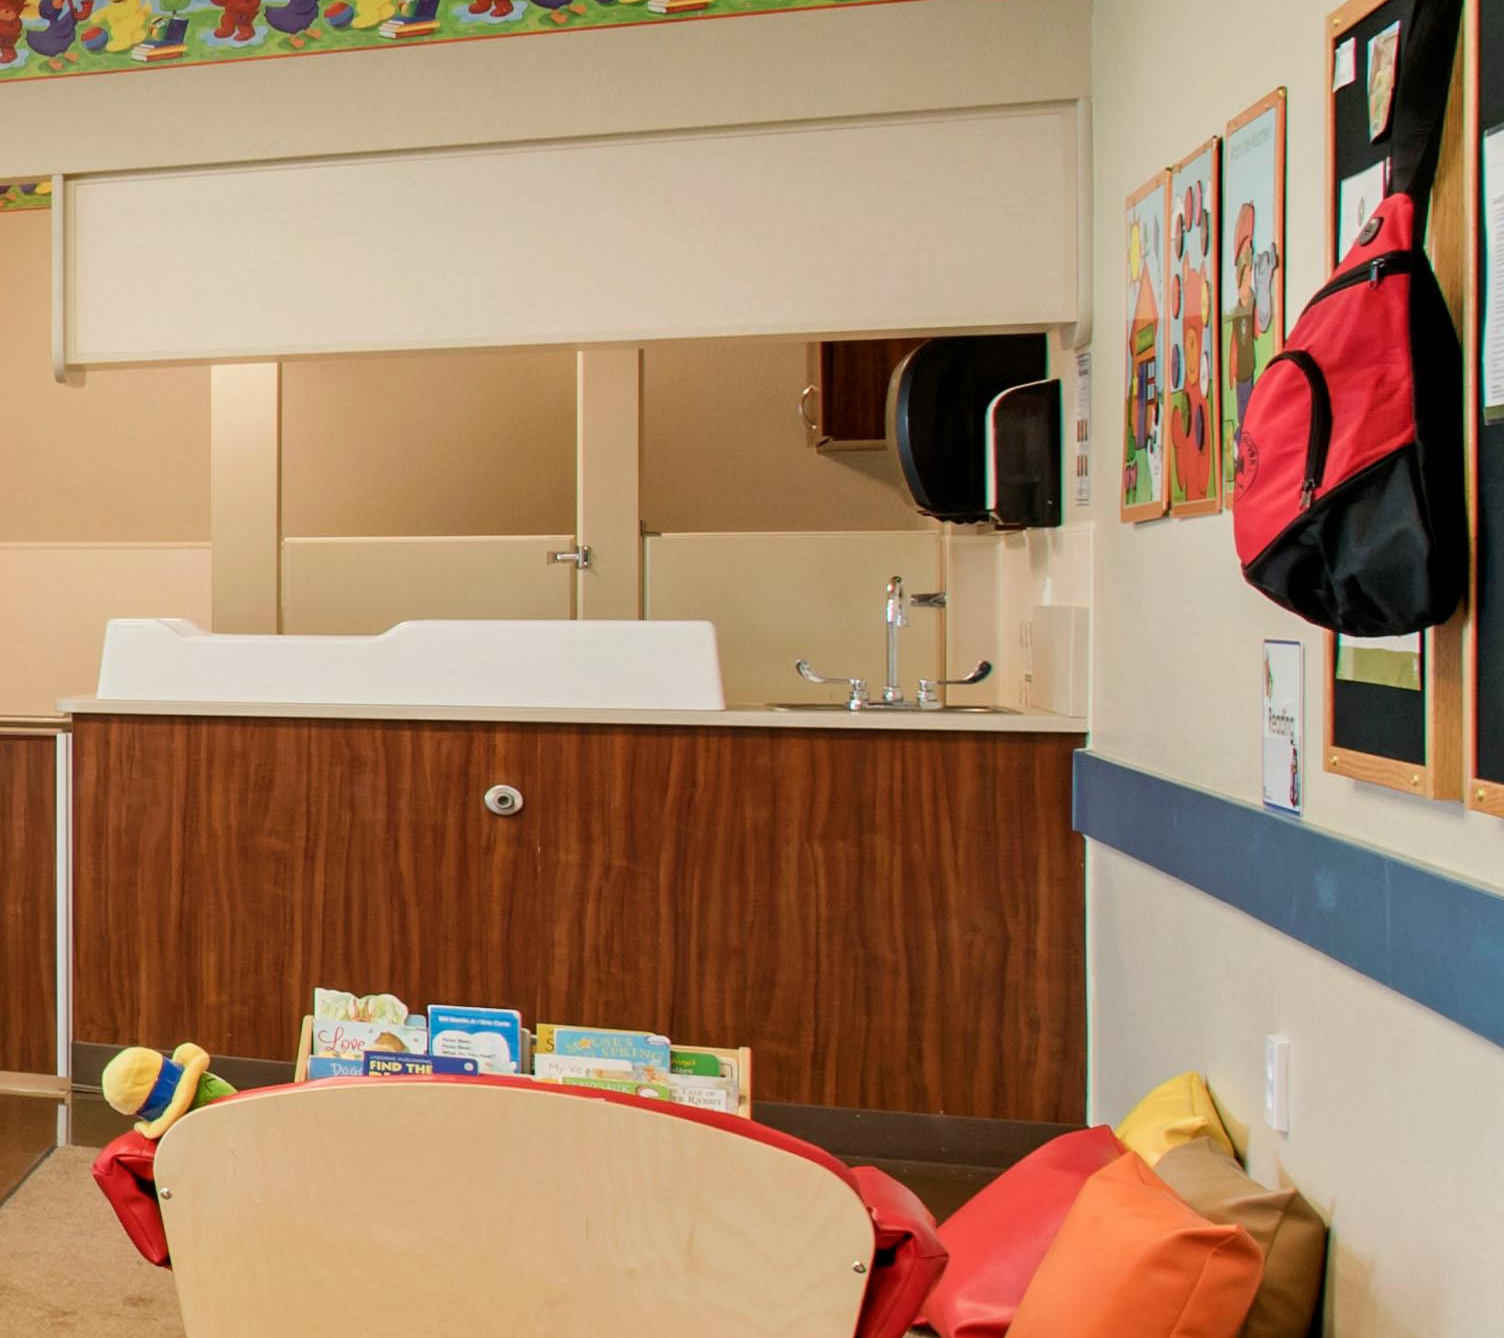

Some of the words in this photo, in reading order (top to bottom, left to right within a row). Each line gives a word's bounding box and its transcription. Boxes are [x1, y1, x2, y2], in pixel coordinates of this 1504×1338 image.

[317, 1026, 365, 1052] Love
[369, 1060, 402, 1072] FIND
[406, 1063, 433, 1075] THE
